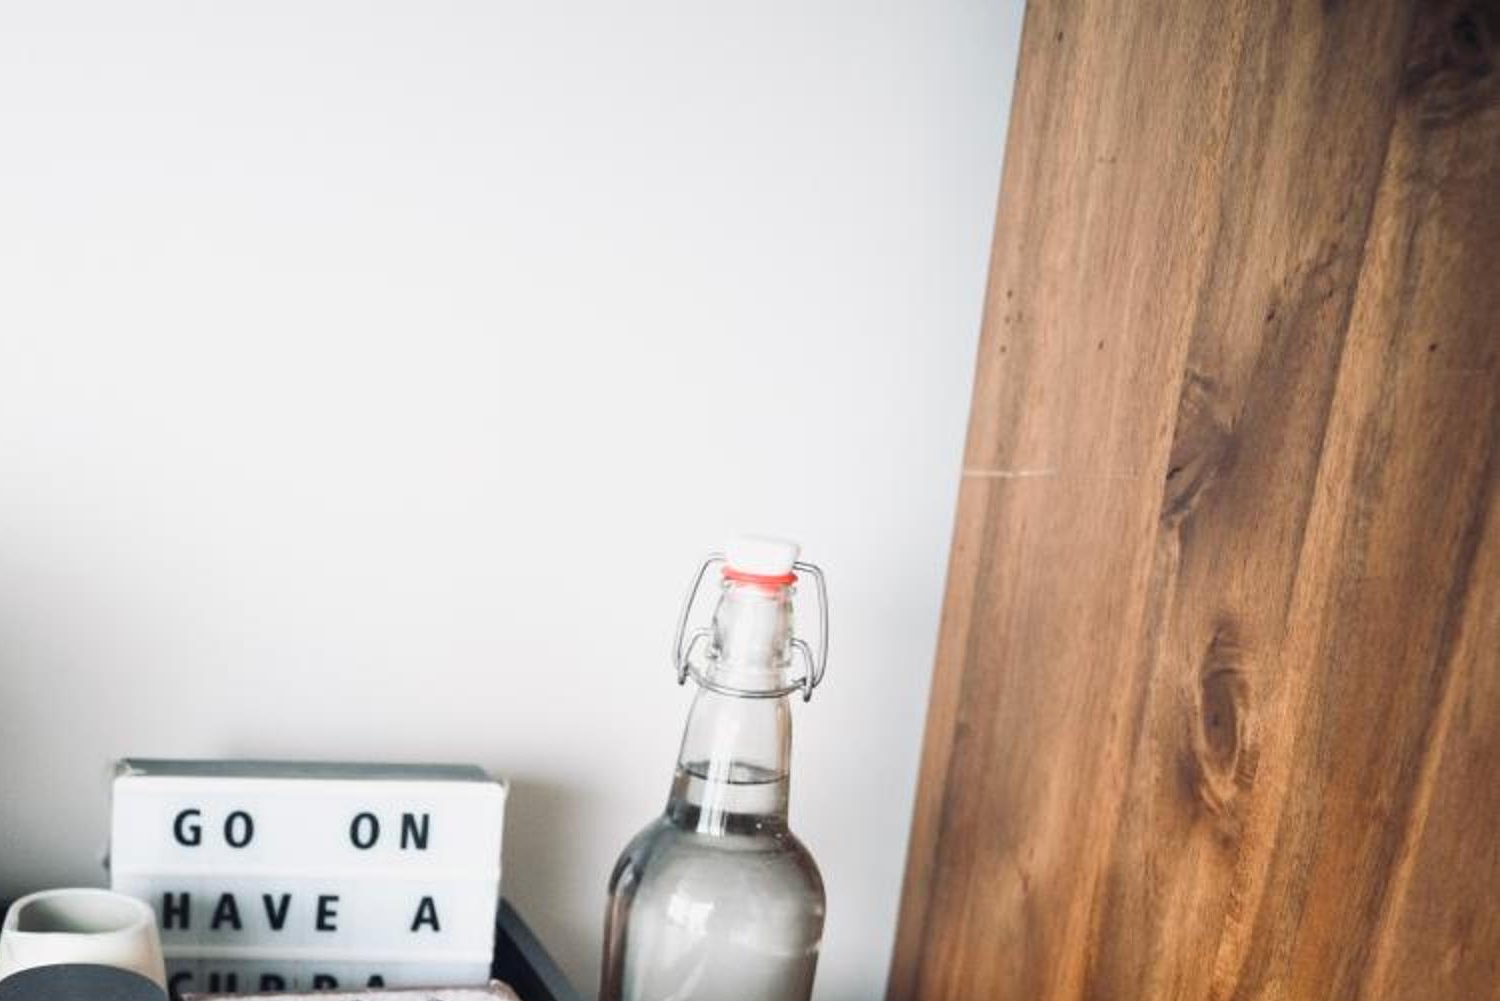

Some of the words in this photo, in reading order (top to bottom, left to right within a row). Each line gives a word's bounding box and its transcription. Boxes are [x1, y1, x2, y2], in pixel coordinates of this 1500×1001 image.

[172, 809, 254, 847] GO
[349, 812, 430, 850] ON
[161, 891, 339, 931] HAVE
[410, 896, 440, 932] A
